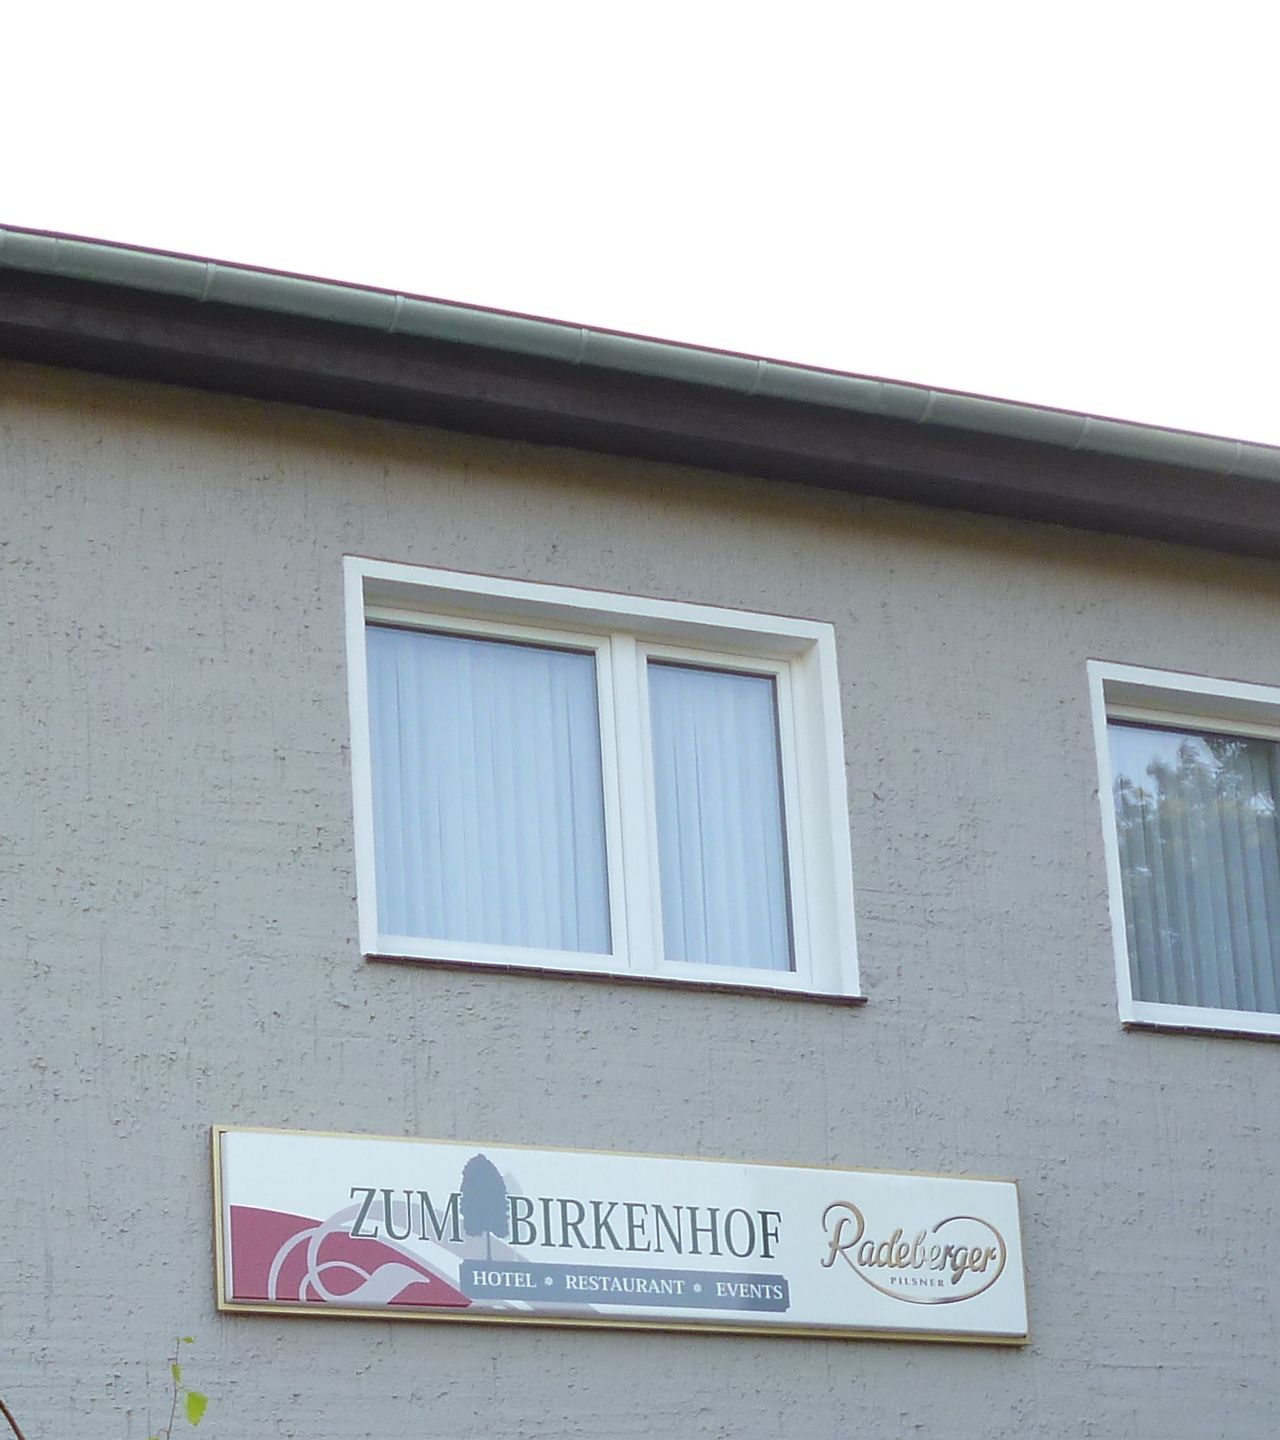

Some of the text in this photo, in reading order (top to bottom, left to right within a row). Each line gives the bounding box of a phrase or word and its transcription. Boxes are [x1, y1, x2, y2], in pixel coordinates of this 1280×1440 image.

[350, 1187, 782, 1259] ZUM BIRKENHOF
[821, 1200, 1000, 1288] Radeberger
[472, 1270, 784, 1300] HOTEL RESTAURANT EVENTS
[890, 1276, 945, 1287] PILSNER
